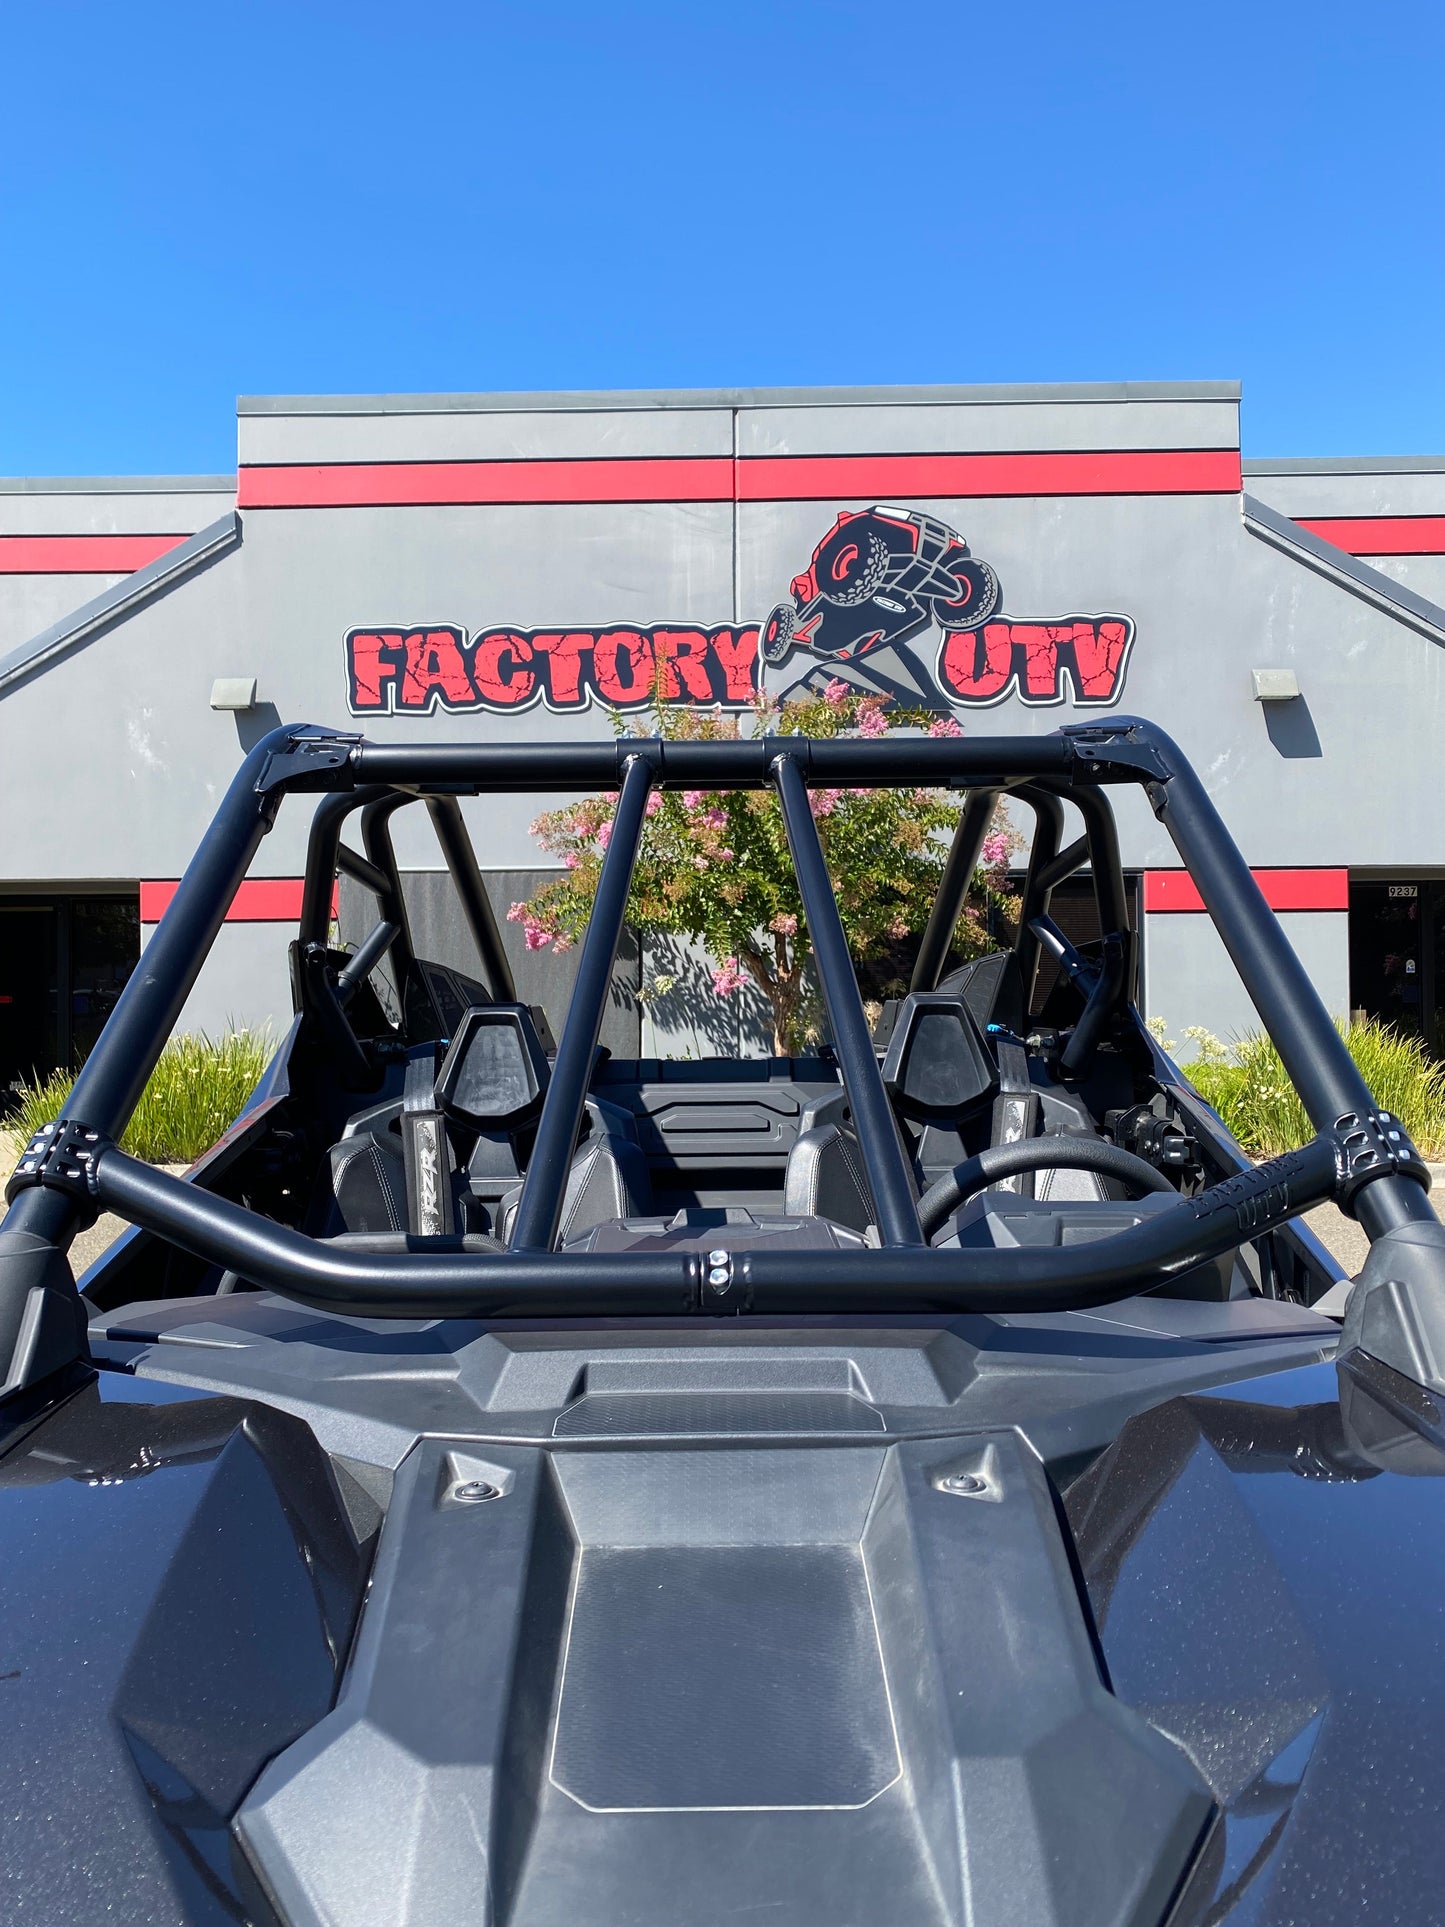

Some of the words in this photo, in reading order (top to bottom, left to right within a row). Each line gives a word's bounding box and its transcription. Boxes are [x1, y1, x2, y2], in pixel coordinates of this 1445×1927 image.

[349, 627, 764, 708] FACTORY
[942, 618, 1129, 699] UTV
[1389, 887, 1416, 896] 9237
[420, 1147, 440, 1216] RZR
